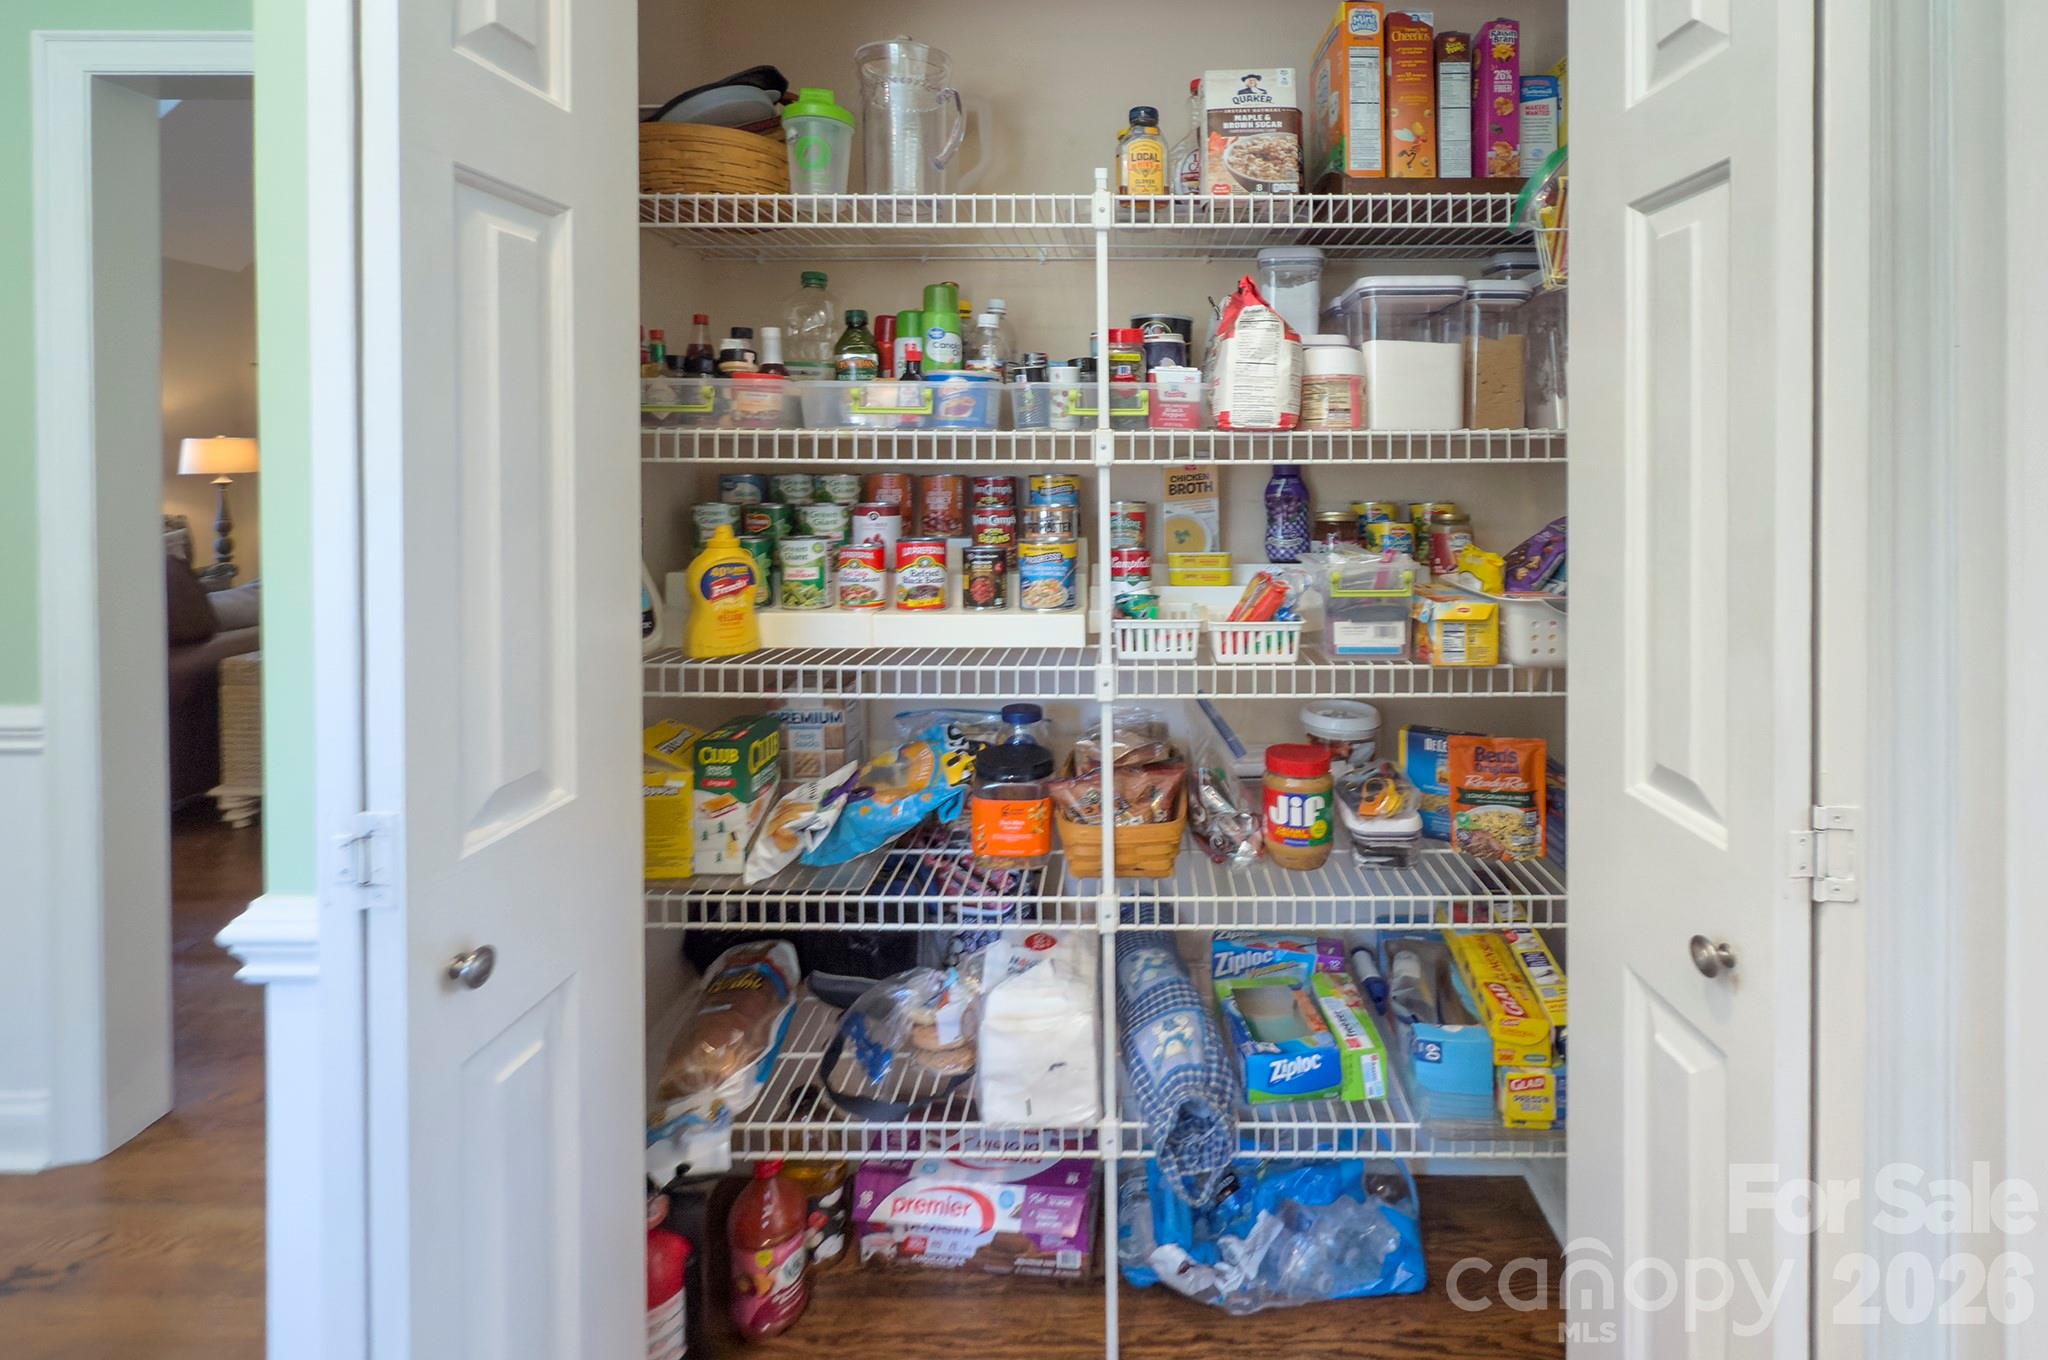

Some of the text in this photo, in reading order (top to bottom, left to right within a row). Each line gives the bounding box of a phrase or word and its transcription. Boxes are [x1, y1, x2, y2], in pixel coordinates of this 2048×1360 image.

[1391, 31, 1430, 42] Cheerios
[1232, 94, 1273, 105] QUAKER
[1222, 121, 1283, 129] BROWN SUGAR
[1233, 114, 1262, 122] MAPLE
[1130, 152, 1161, 163] LOCAL
[1169, 473, 1210, 483] CHICKEN
[1168, 481, 1214, 495] BROTH
[698, 746, 741, 766] CLUB
[1474, 746, 1518, 763] Ben's
[1268, 794, 1326, 828] Jif
[1213, 948, 1276, 979] Ziploc
[1269, 1053, 1323, 1085] Ziploc
[1509, 1076, 1545, 1091] GLAD
[890, 1194, 972, 1218] premier
